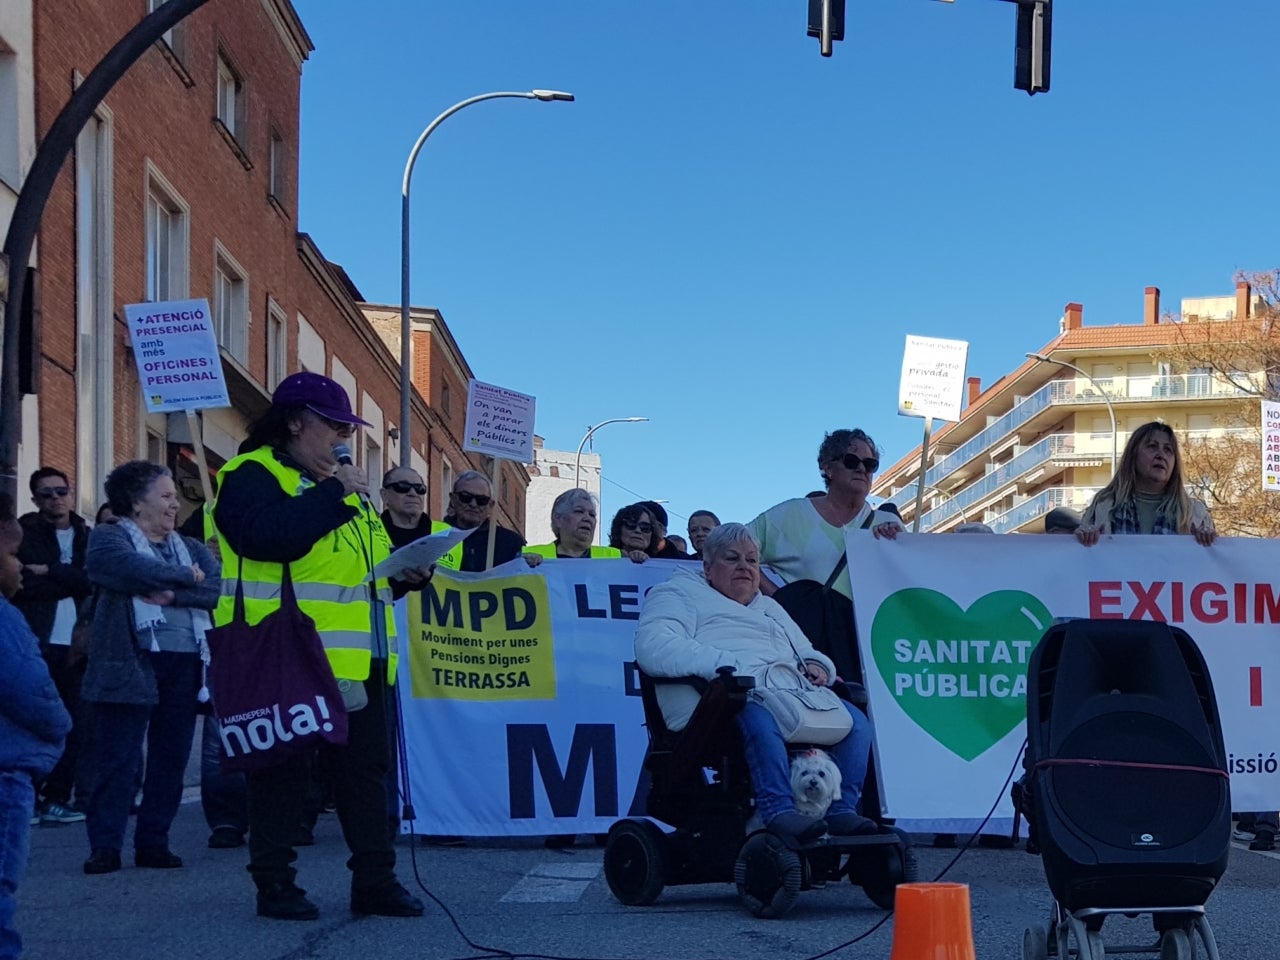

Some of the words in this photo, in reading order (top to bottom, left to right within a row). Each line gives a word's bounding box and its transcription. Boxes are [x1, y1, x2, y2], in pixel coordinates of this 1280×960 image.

[140, 339, 164, 349] amb
[143, 348, 166, 358] més
[147, 372, 218, 386] PERSONAL
[908, 368, 949, 378] privada
[474, 400, 490, 410] On
[494, 406, 512, 415] van
[1266, 410, 1280, 419] NO
[492, 414, 524, 424] parar
[476, 420, 490, 428] els
[494, 424, 528, 436] diners
[476, 430, 516, 444] Públics
[420, 582, 538, 632] MPD
[421, 630, 483, 648] Moviment
[486, 637, 506, 650] per
[510, 637, 538, 648] unes
[430, 648, 485, 665] Pensions
[488, 654, 530, 668] Dignes
[894, 639, 1032, 664] SANITAT
[432, 668, 530, 689] TERRASSA
[896, 668, 1028, 698] PÚBLICA
[1249, 666, 1262, 707] I
[224, 708, 271, 724] MATADEPERA
[1228, 752, 1278, 774] issió
